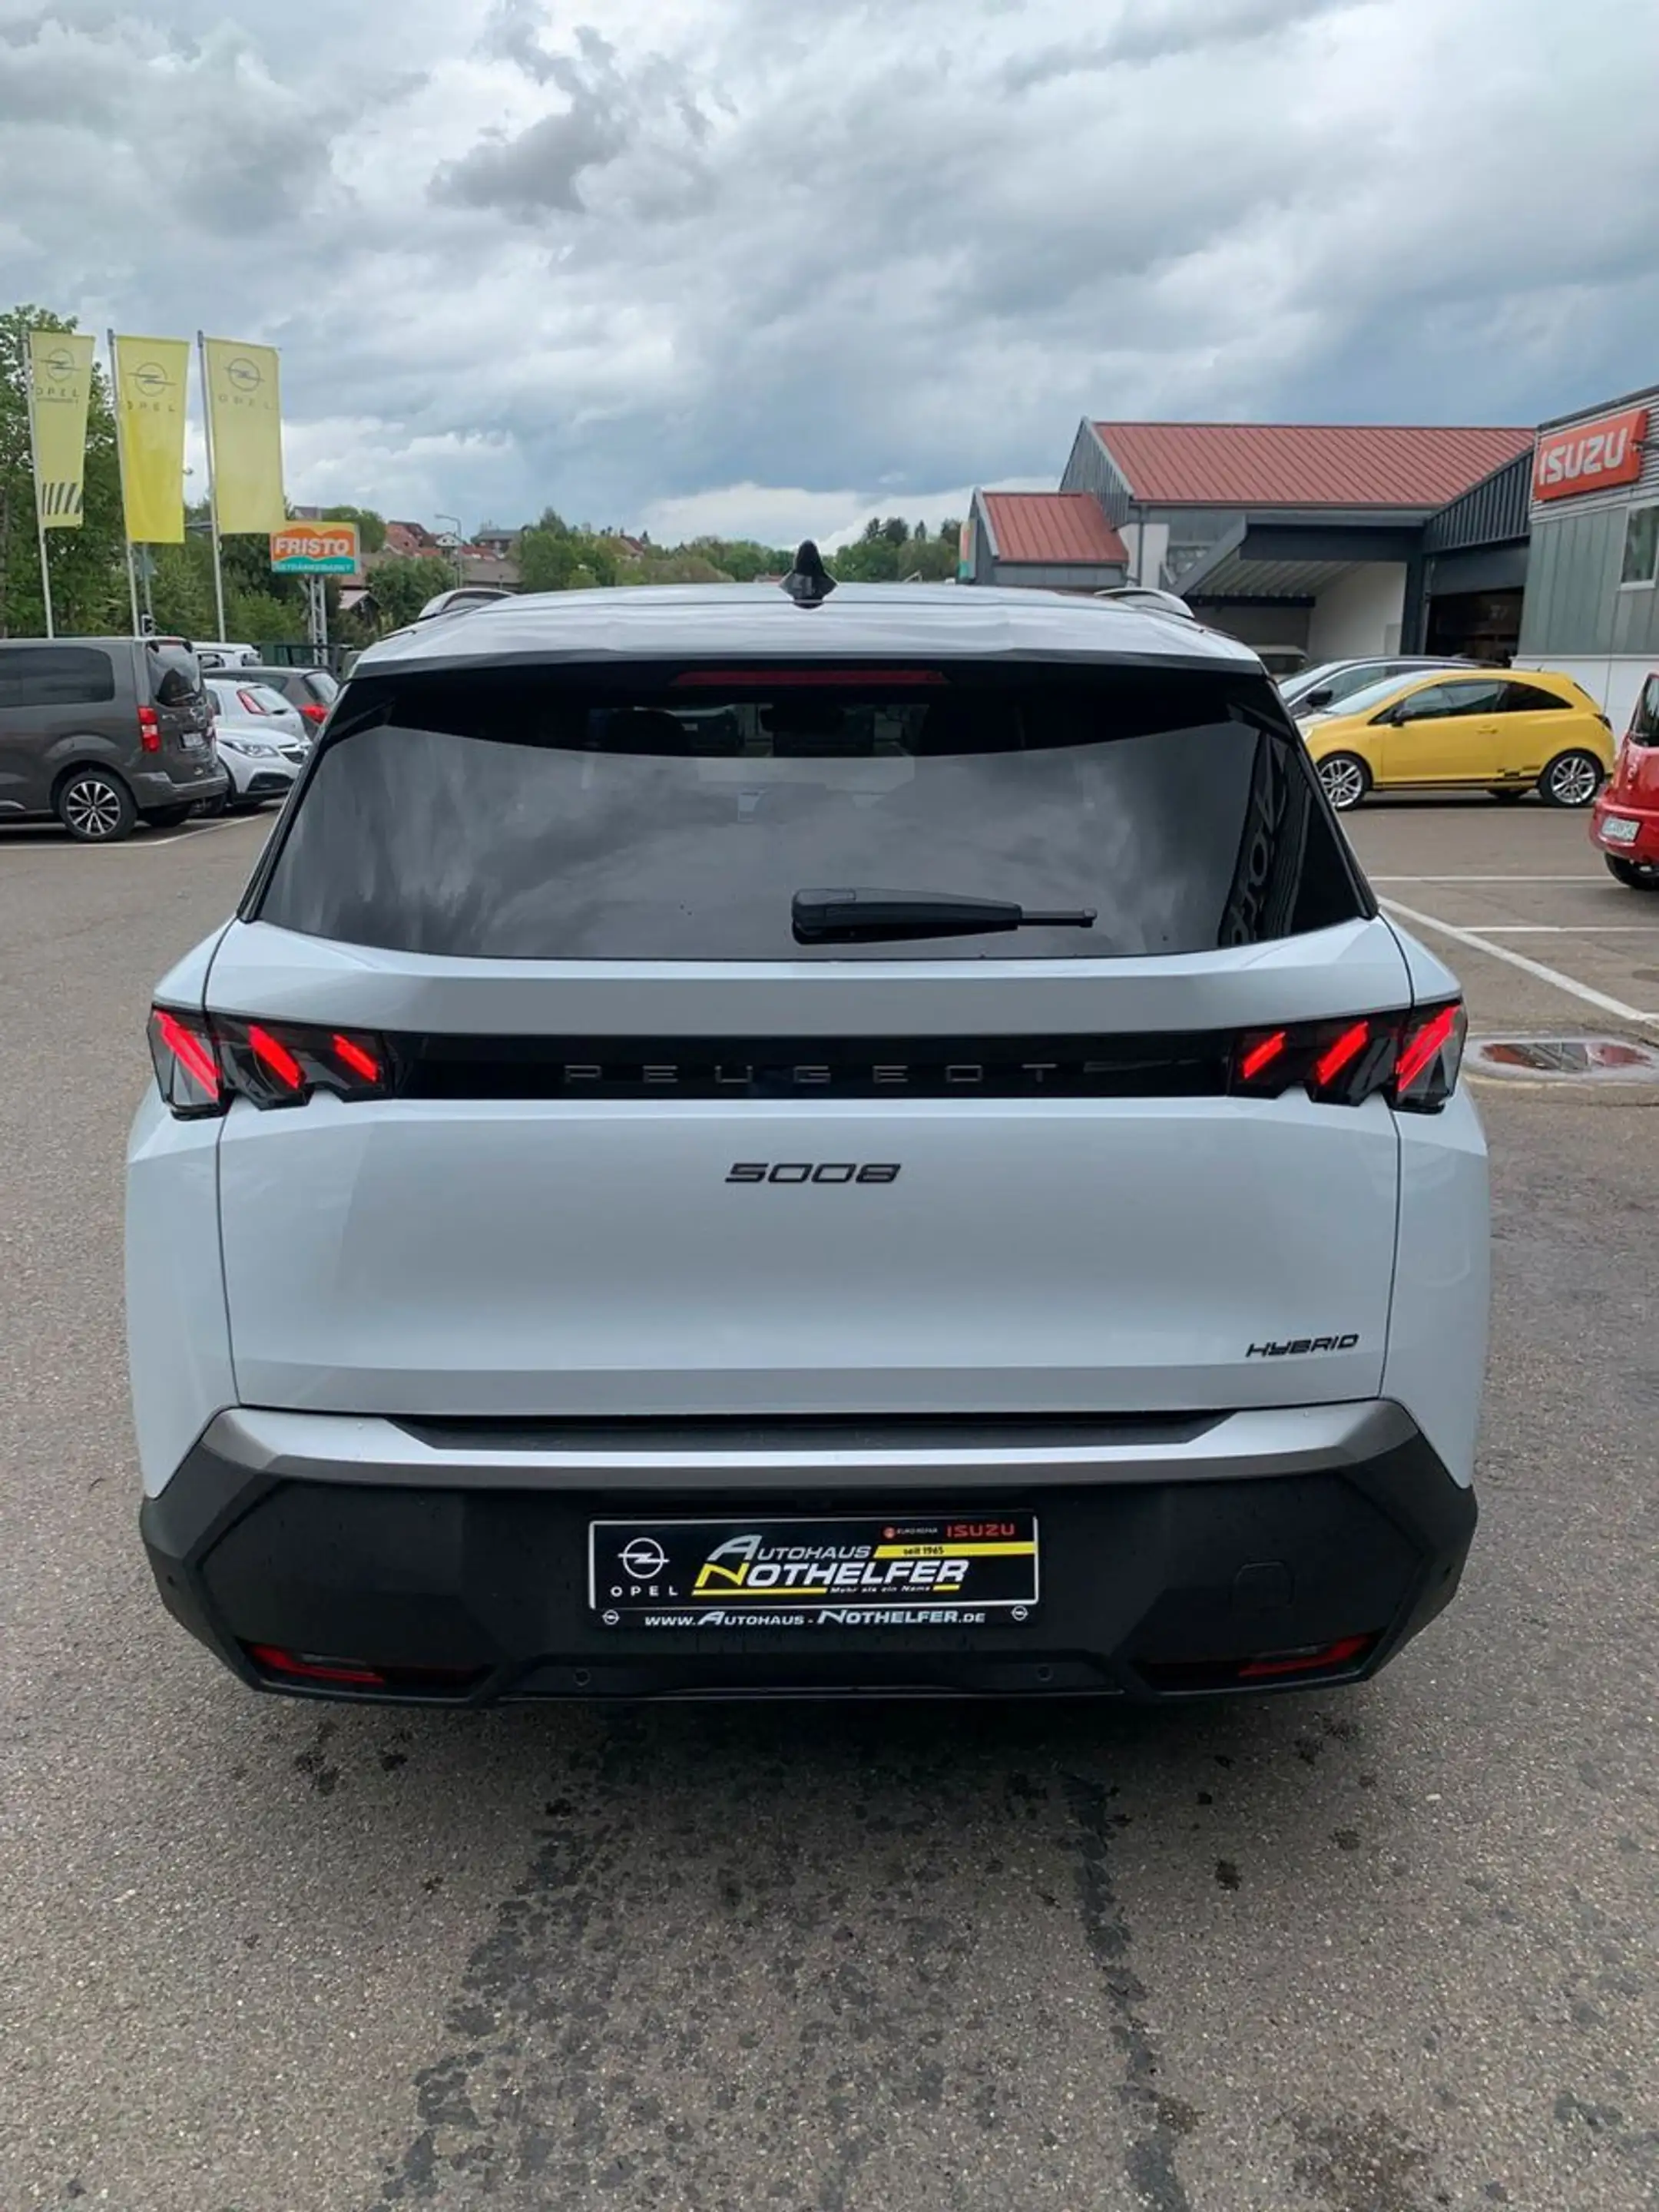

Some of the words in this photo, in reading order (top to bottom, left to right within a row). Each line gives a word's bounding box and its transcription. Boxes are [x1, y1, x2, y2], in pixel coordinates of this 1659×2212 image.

[35, 386, 81, 398] OPEL
[1538, 427, 1628, 485] ISUZU
[275, 537, 350, 555] FRISTO
[565, 1063, 1058, 1083] PEUGEOT
[724, 1163, 902, 1184] 5008
[1245, 1333, 1359, 1358] HYBRID
[947, 1523, 1015, 1538] ISUZU
[707, 1534, 872, 1561] AUTOHAUS
[922, 1545, 945, 1555] 1965
[694, 1559, 970, 1588] NOTHELFER
[610, 1584, 679, 1598] OPEL
